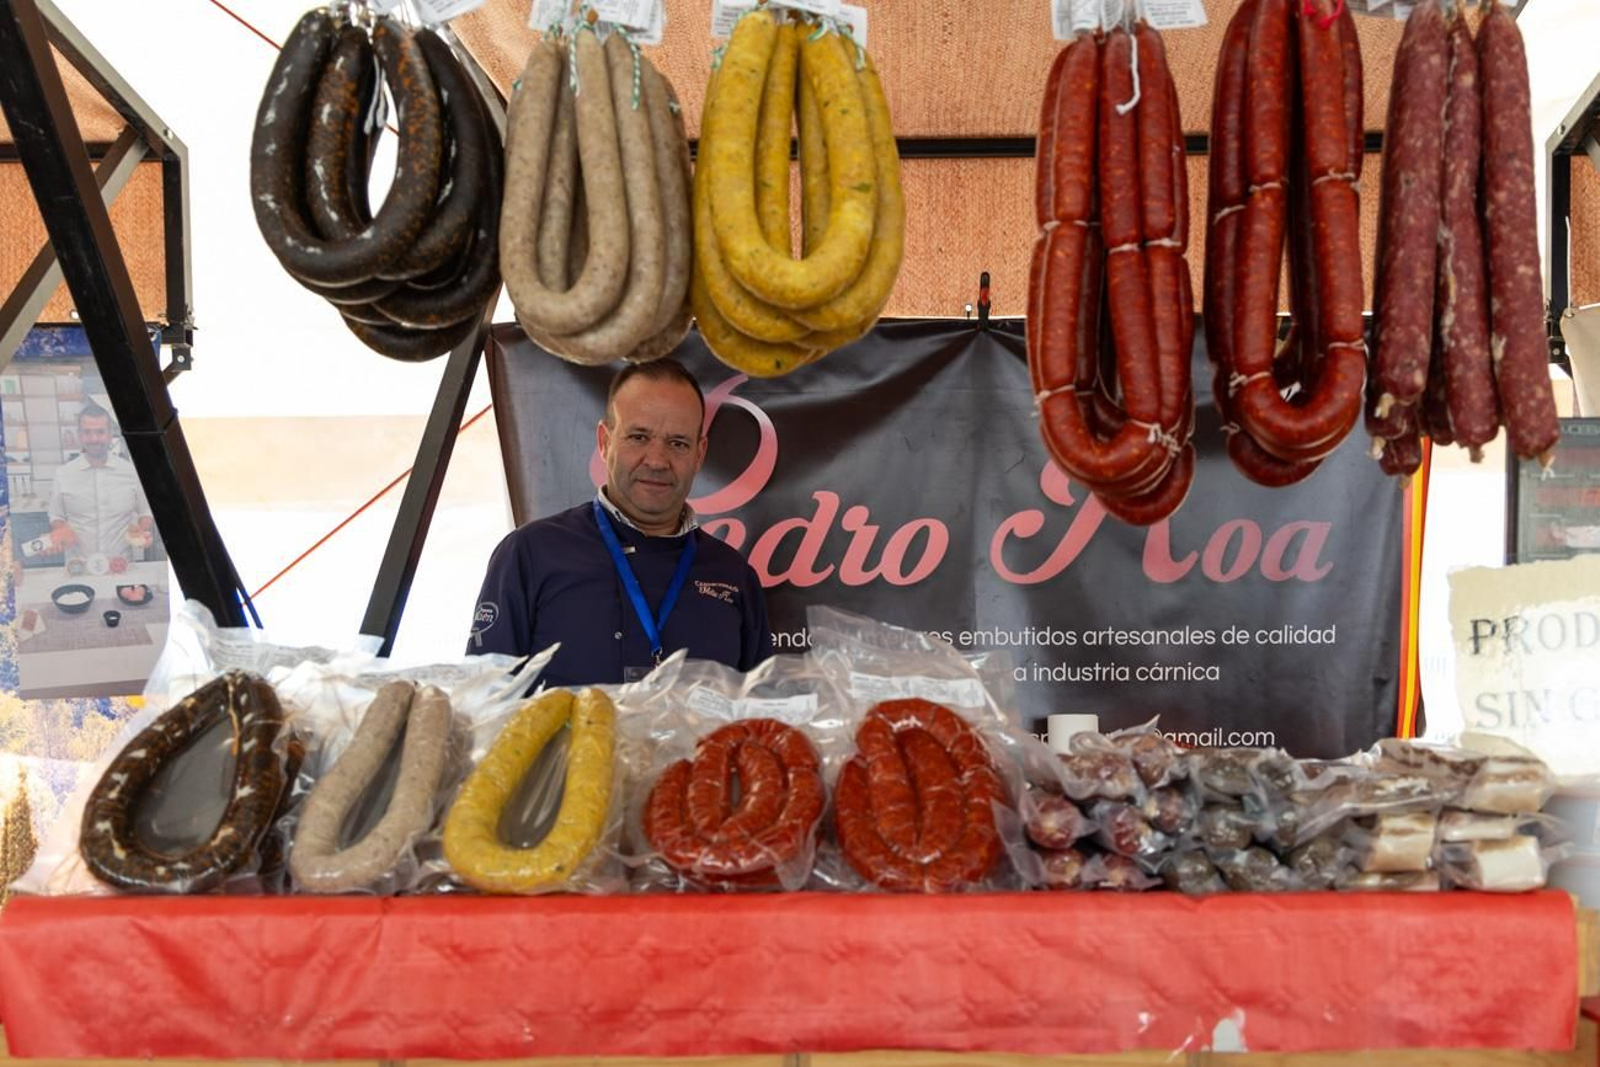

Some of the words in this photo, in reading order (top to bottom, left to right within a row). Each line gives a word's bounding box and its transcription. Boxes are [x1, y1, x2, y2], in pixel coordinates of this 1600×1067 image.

[959, 626, 1078, 646] embutidos
[1082, 626, 1216, 646] artesanales
[1221, 625, 1250, 645] de
[1255, 625, 1336, 645] calidad
[1033, 663, 1130, 683] industria
[1135, 663, 1220, 682] cárnica
[1475, 689, 1550, 729] SIN
